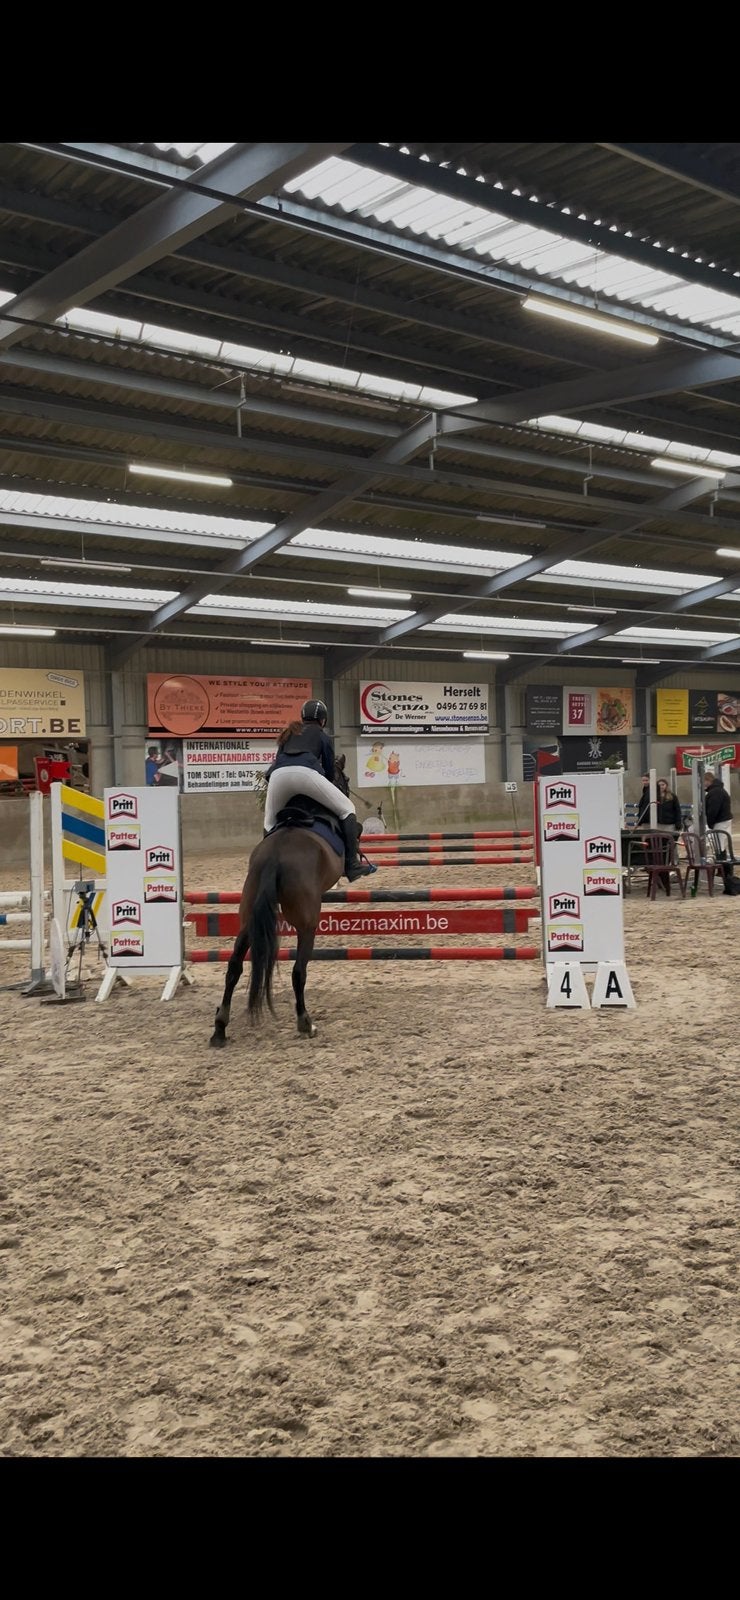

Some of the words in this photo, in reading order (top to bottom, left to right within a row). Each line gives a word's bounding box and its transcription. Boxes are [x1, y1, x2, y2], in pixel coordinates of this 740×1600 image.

[371, 691, 423, 702] Stones
[443, 686, 481, 697] Herselt
[436, 702, 457, 711] 0496
[458, 702, 468, 711] 27
[468, 702, 479, 711] 69
[479, 702, 488, 711] 81
[186, 740, 250, 750] INTERNATIONALE
[187, 753, 260, 762] PAARDENTANDARTS
[187, 771, 202, 779] TOM
[203, 771, 220, 779] SUNT
[549, 788, 572, 799] Pritt
[112, 800, 134, 810] Pritt
[546, 821, 577, 830] Pattex
[110, 832, 138, 840] Pattex
[589, 843, 612, 853] Pritt
[149, 852, 170, 862] Pritt
[586, 876, 617, 885] Pattex
[146, 884, 175, 893] Pattex
[553, 899, 576, 909] Pritt
[116, 906, 137, 916] Pritt
[550, 932, 581, 941] Pattex
[113, 938, 141, 946] Pattex
[560, 971, 572, 999] 4
[605, 971, 623, 999] A
